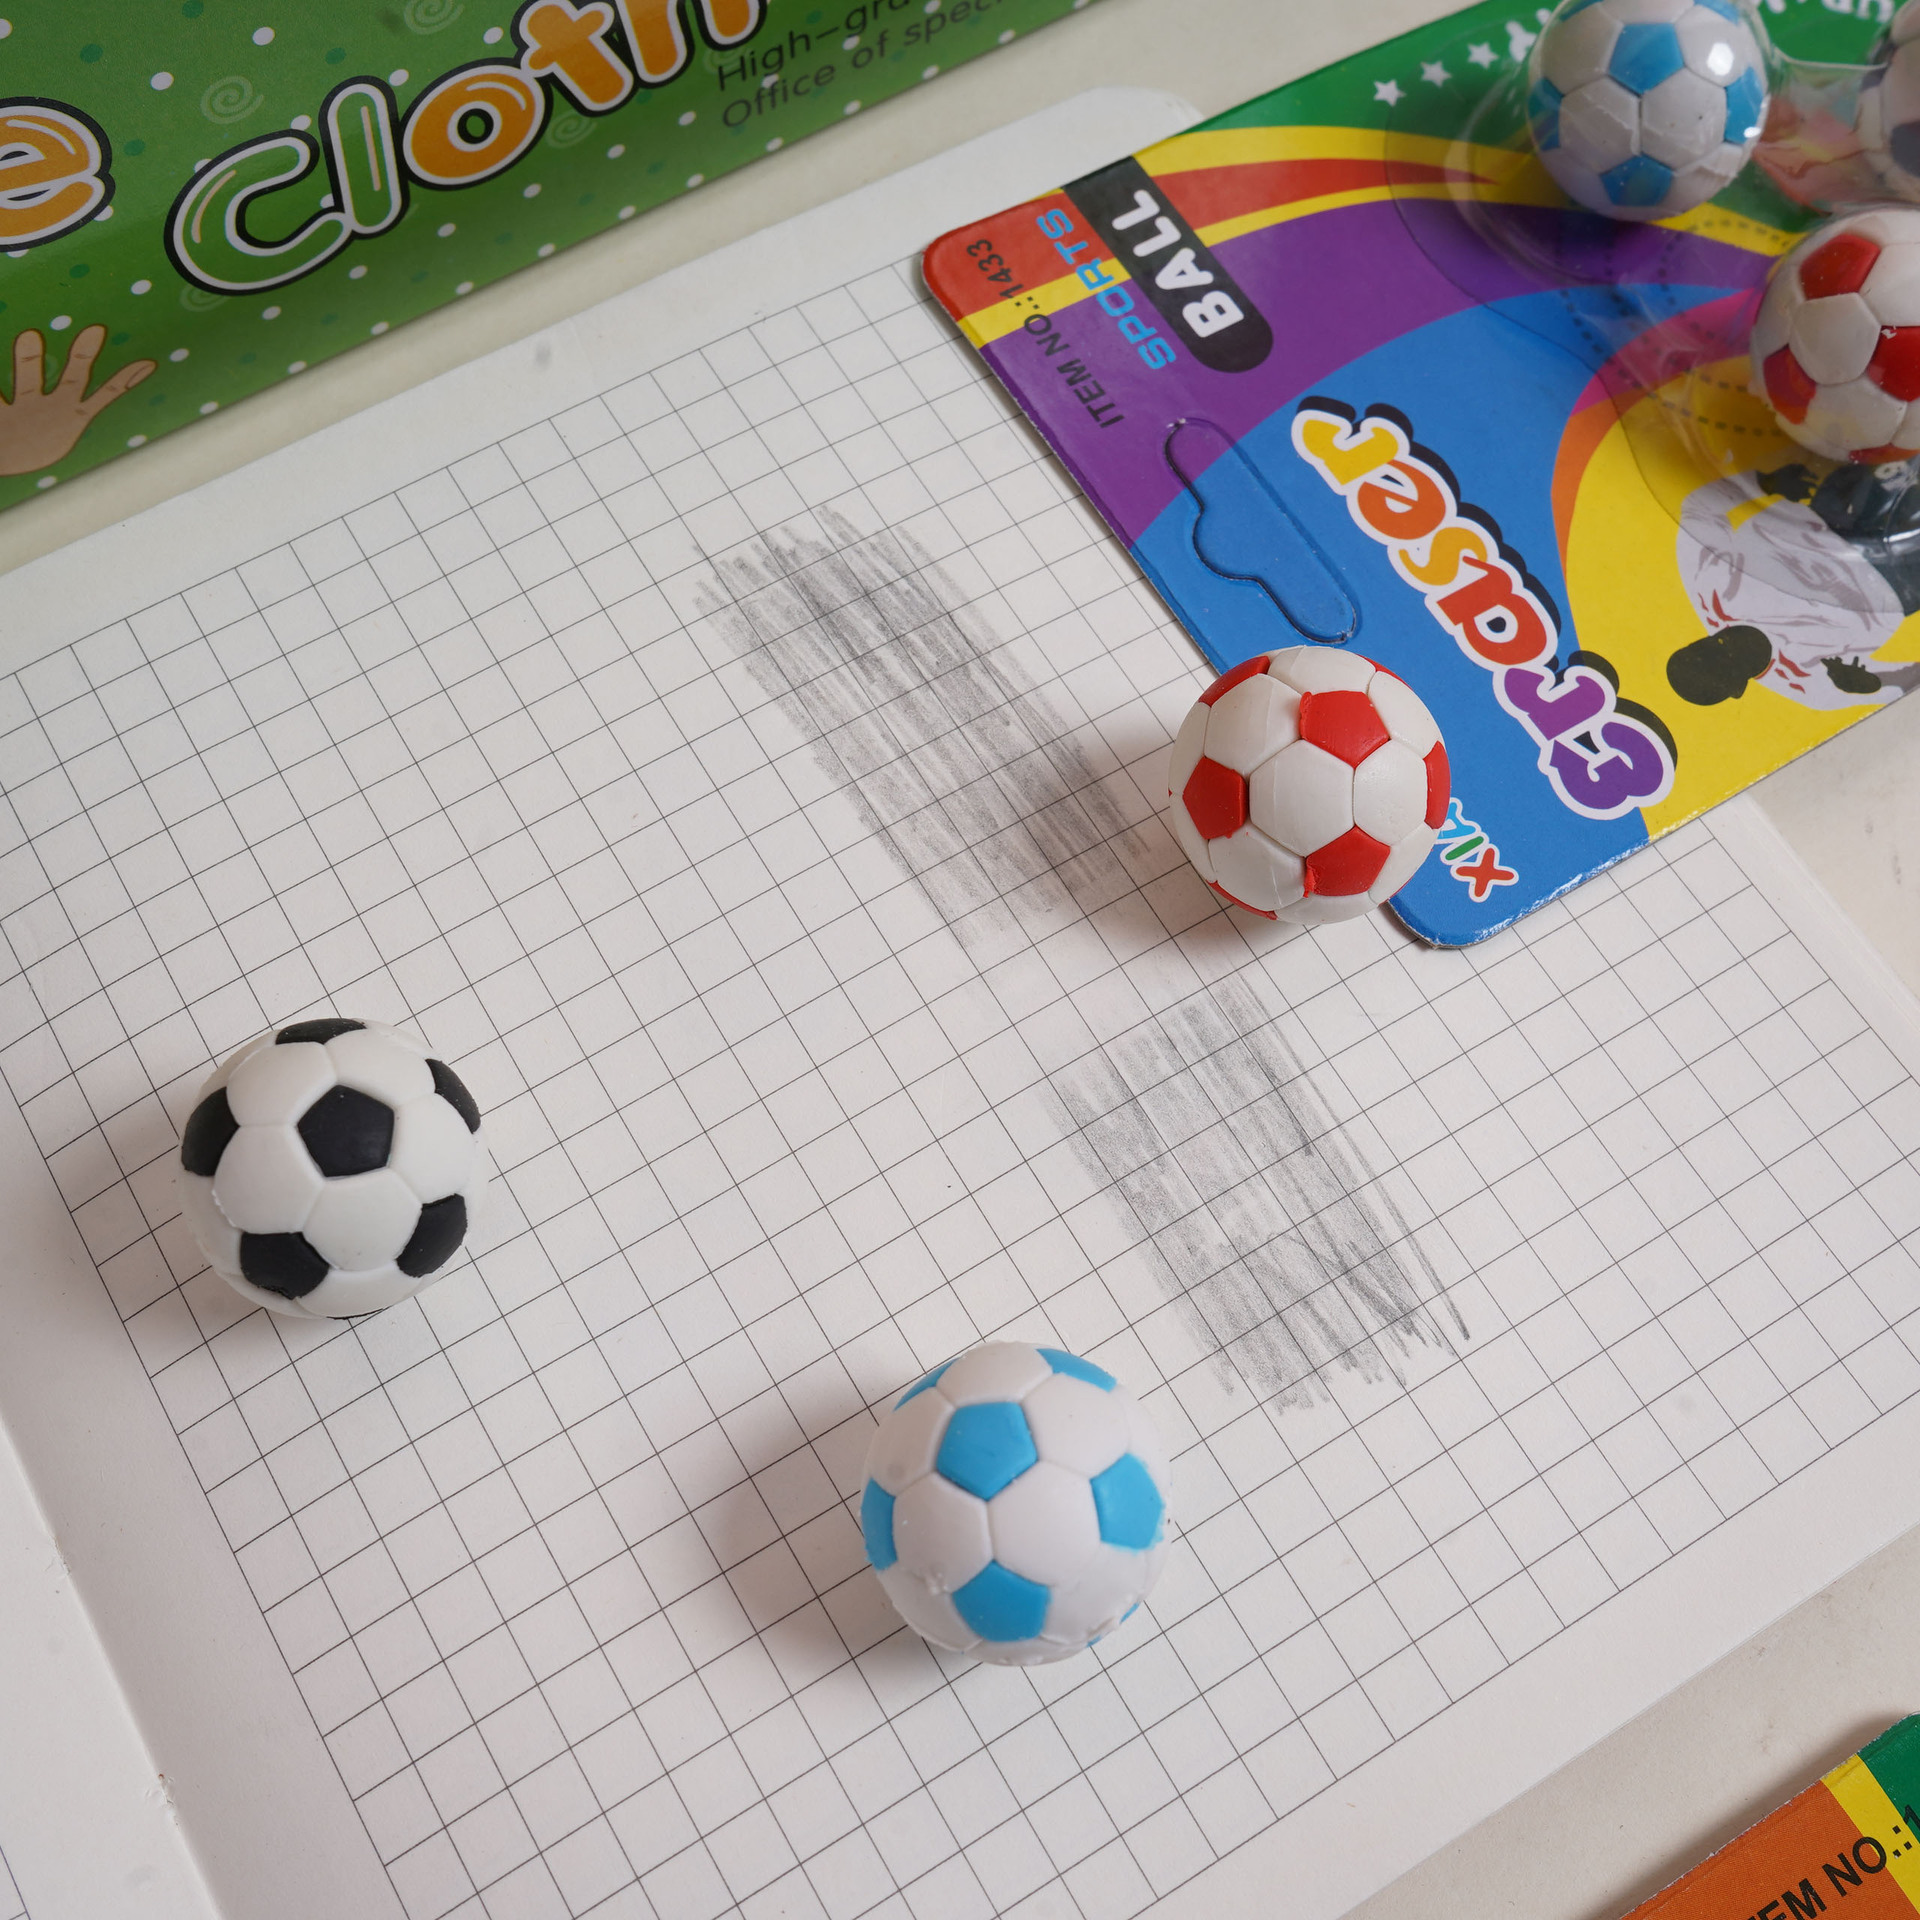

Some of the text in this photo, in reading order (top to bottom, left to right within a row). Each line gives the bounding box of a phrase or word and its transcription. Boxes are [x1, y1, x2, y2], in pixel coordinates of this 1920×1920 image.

[722, 64, 835, 128] Office
[851, 30, 890, 70] of
[1036, 208, 1177, 370] SPORTS
[1111, 188, 1245, 339] BALL
[1056, 357, 1126, 429] ITEM
[1292, 407, 1674, 820] Eraser
